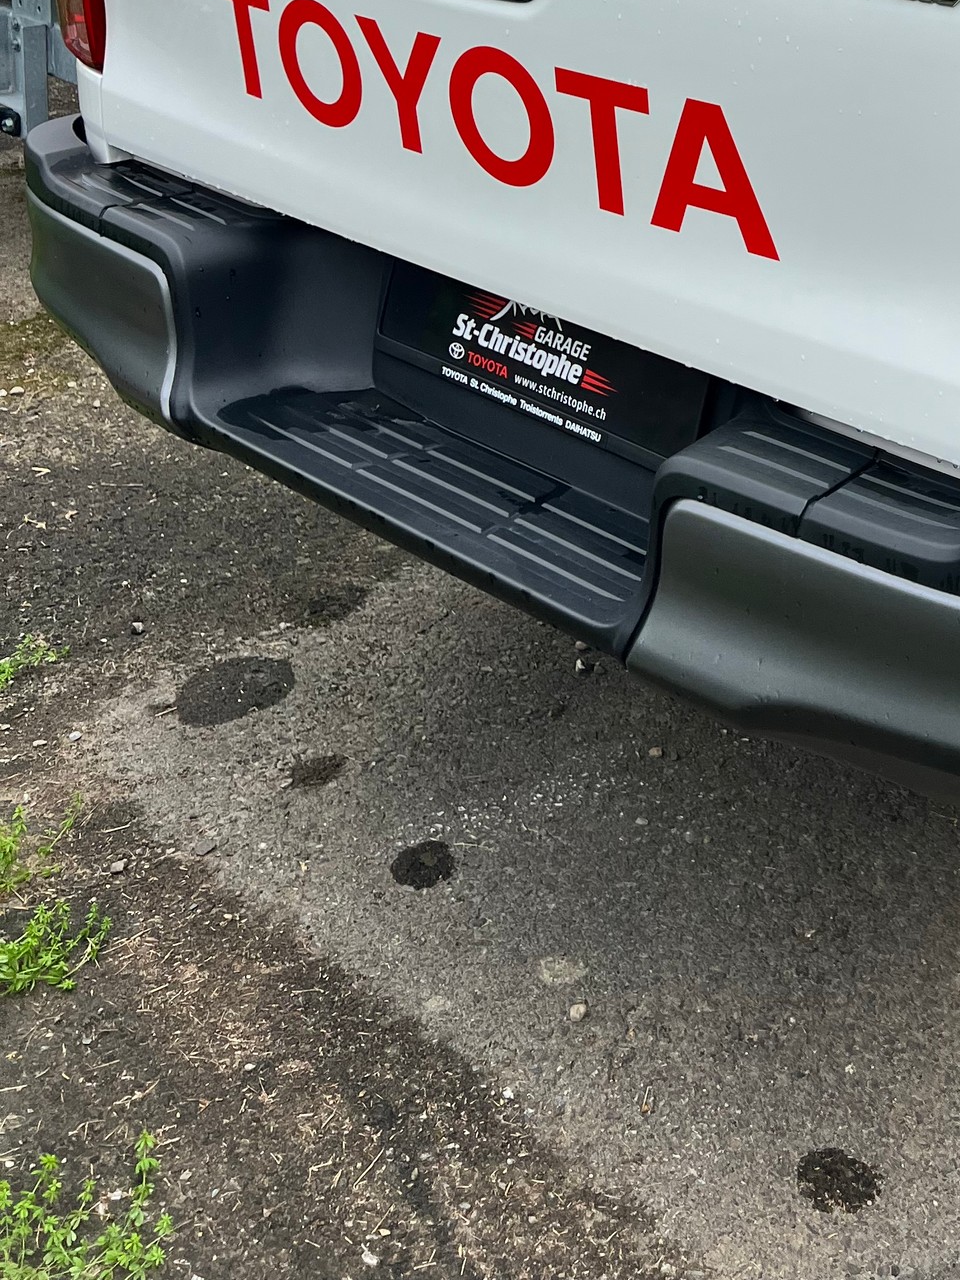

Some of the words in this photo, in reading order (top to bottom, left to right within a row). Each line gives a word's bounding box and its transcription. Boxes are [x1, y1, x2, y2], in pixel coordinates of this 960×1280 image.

[452, 313, 583, 385] St-Christophe
[467, 351, 508, 379] TOYOTA
[534, 326, 592, 361] GARAGE
[441, 365, 468, 385] TOYOTA
[480, 382, 518, 407] Christophe
[564, 420, 602, 443] DAIHATSU
[514, 374, 607, 421] www.stchristophe.ch
